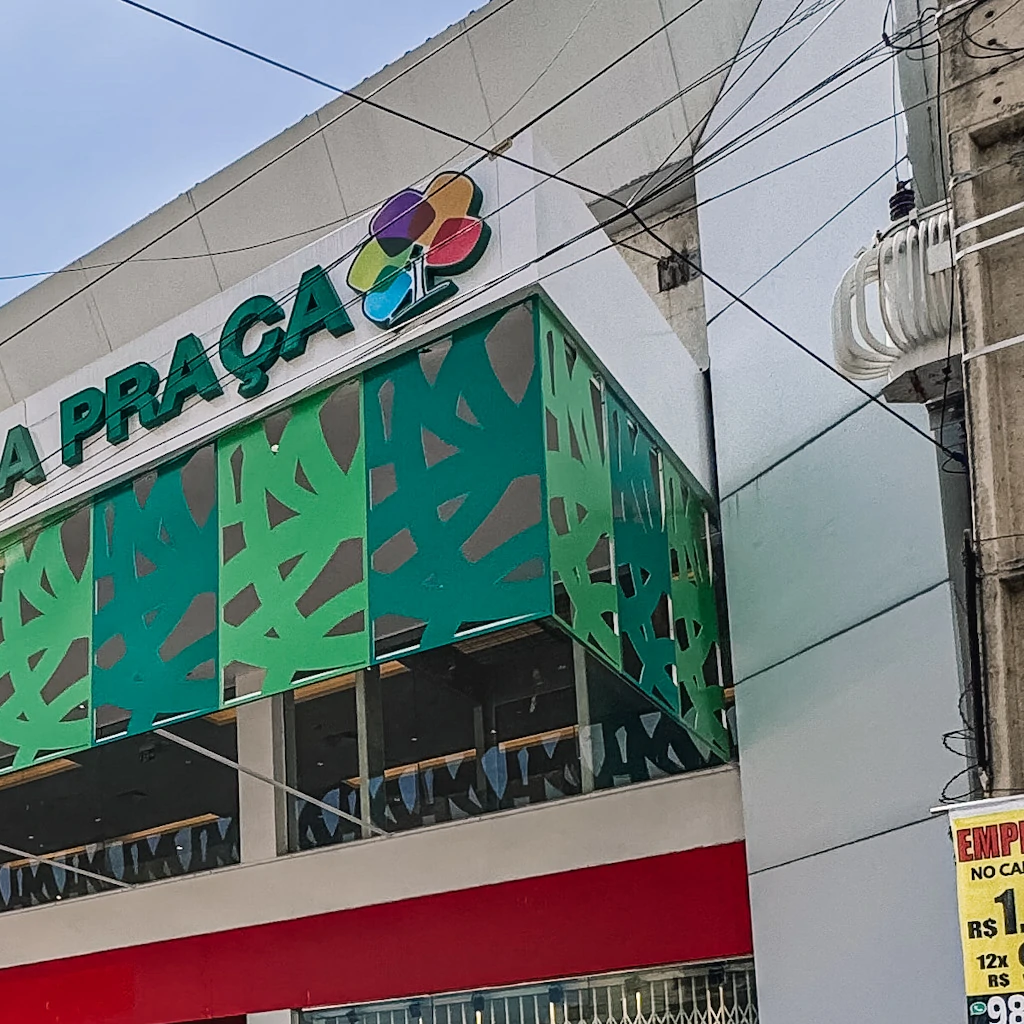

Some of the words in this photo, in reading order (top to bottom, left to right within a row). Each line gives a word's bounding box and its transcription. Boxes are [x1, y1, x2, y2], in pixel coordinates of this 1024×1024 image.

[59, 264, 355, 468] PRAÇA
[971, 865, 996, 881] NO
[999, 861, 1024, 876] CA
[967, 917, 998, 939] R$
[975, 953, 1009, 970] 12x
[987, 972, 1010, 988] R$
